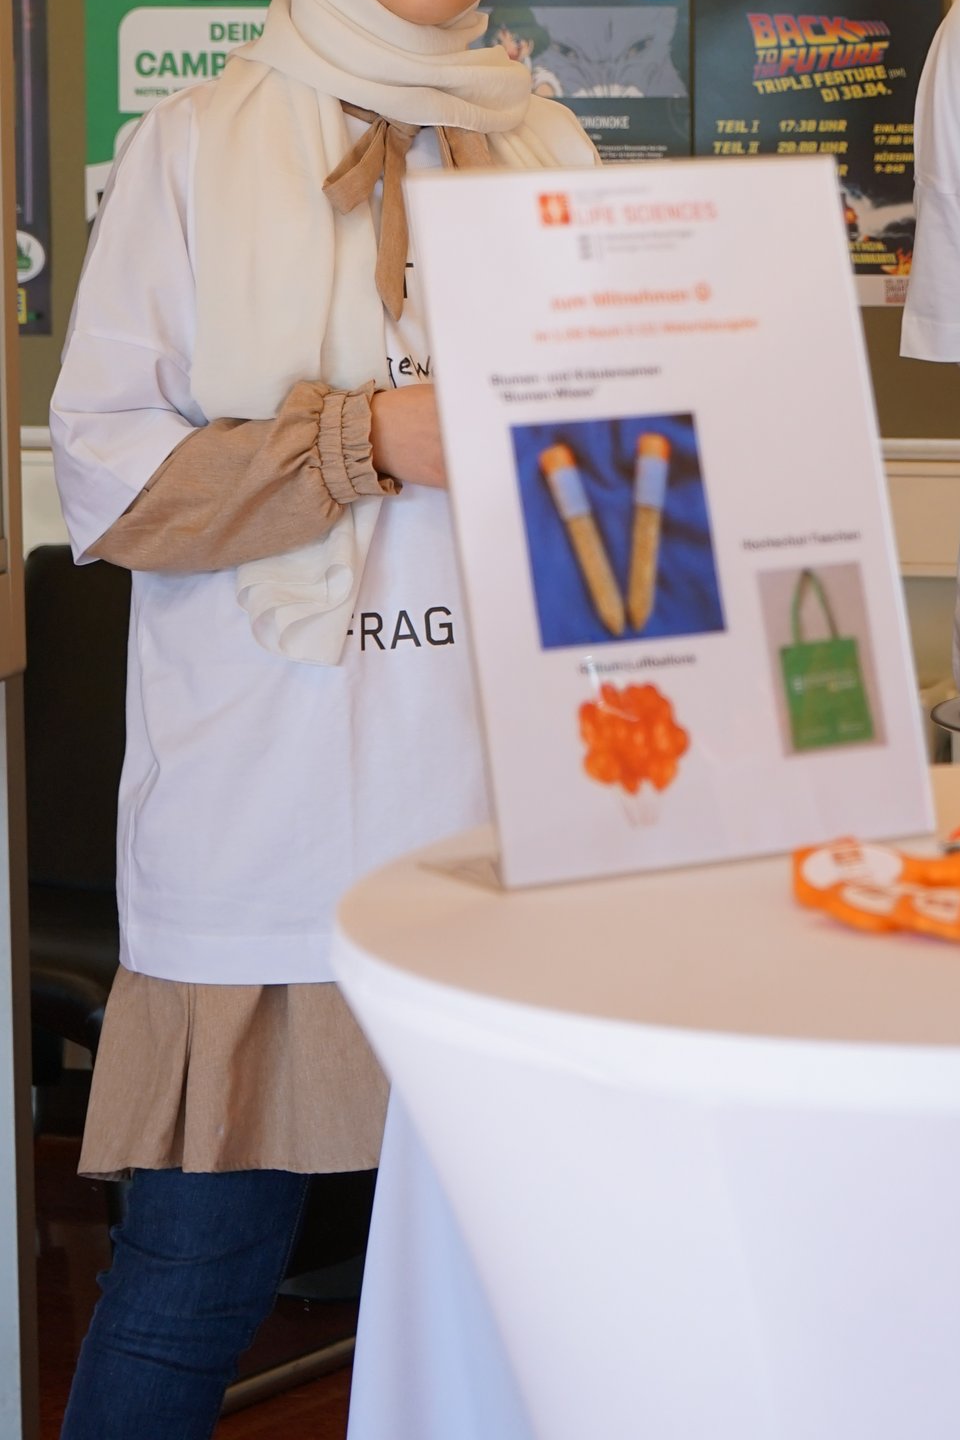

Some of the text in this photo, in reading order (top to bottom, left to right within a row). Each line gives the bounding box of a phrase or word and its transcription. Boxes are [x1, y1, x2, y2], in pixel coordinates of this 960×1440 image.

[210, 23, 265, 42] DEIN
[747, 13, 872, 48] BACK
[756, 49, 778, 64] TO
[779, 41, 890, 78] FUTURE
[753, 73, 813, 95] TRIPLE
[814, 64, 888, 88] FEATURE
[821, 81, 893, 103] DI 30.04.
[716, 120, 749, 134] TEIL
[818, 120, 848, 132] UHR
[713, 141, 746, 154] TEIL
[818, 141, 849, 154] UHR
